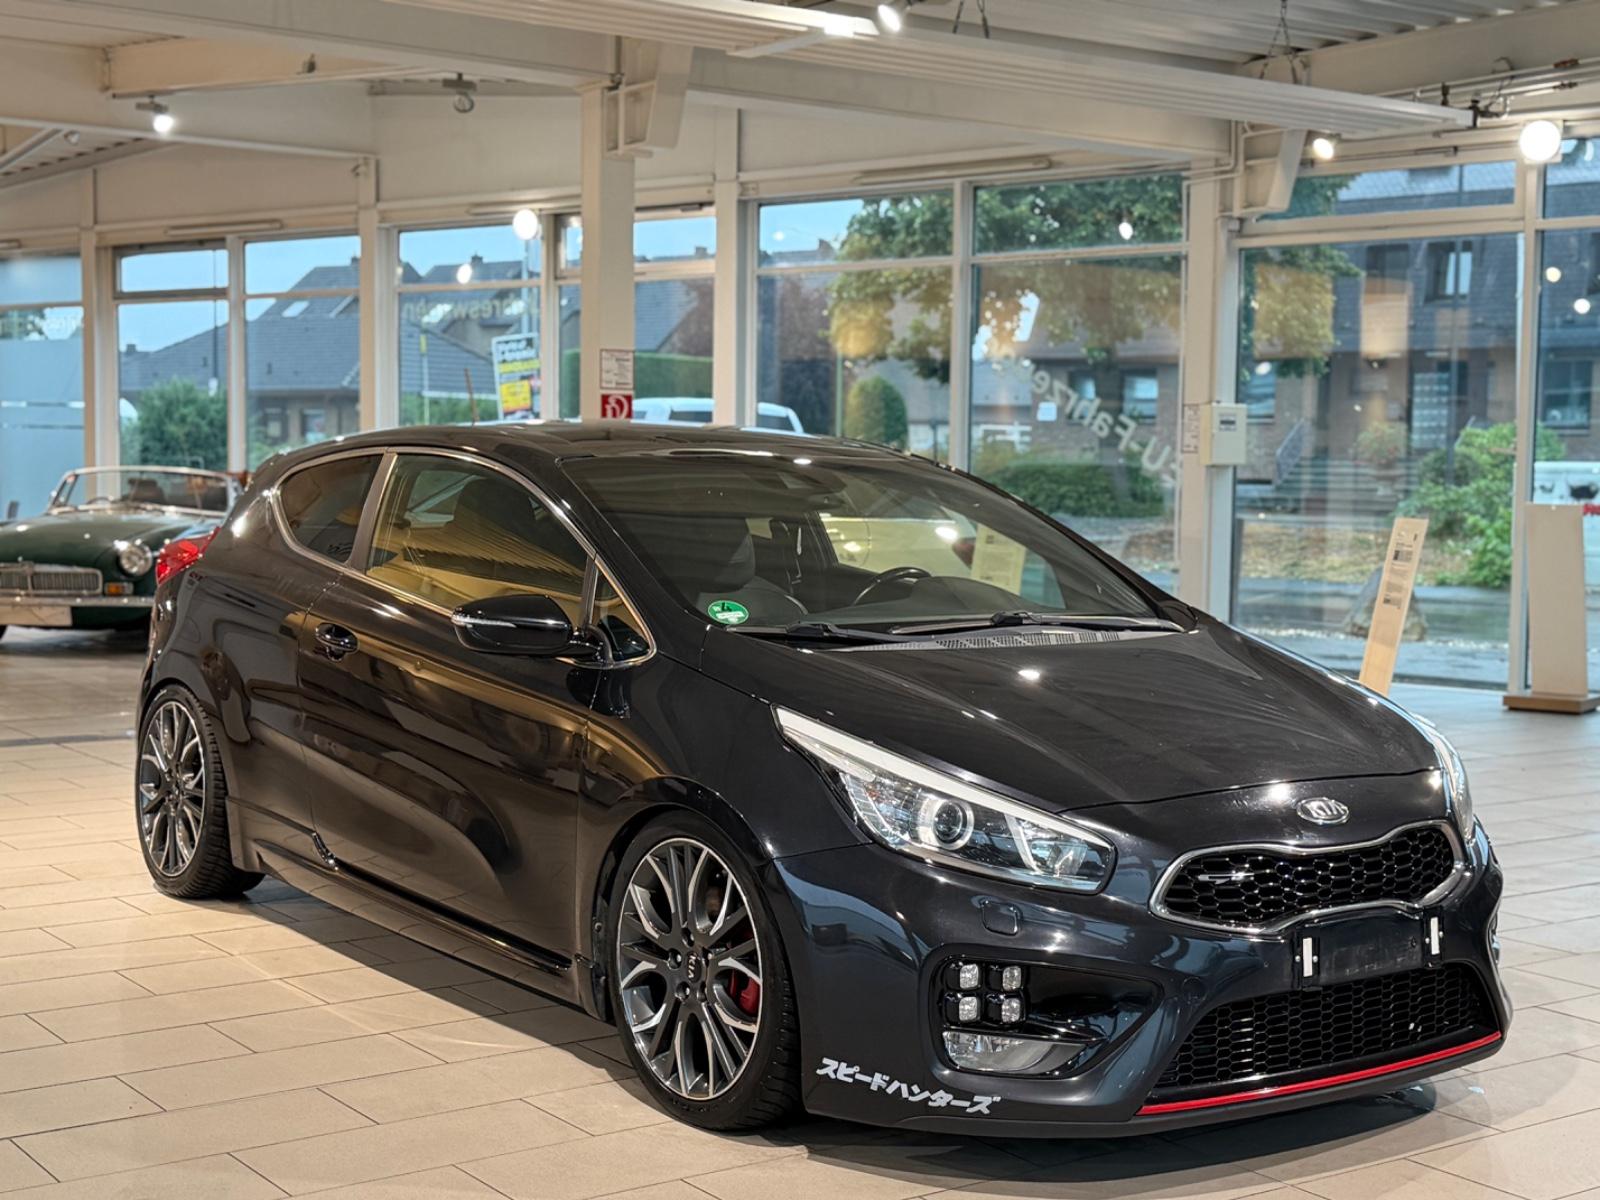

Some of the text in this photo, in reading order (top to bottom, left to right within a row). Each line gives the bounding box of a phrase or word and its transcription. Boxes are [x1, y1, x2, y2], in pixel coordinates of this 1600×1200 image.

[1305, 800, 1345, 818] KIA
[688, 953, 698, 979] KIA
[816, 1057, 1001, 1115] スピードハンターズ
